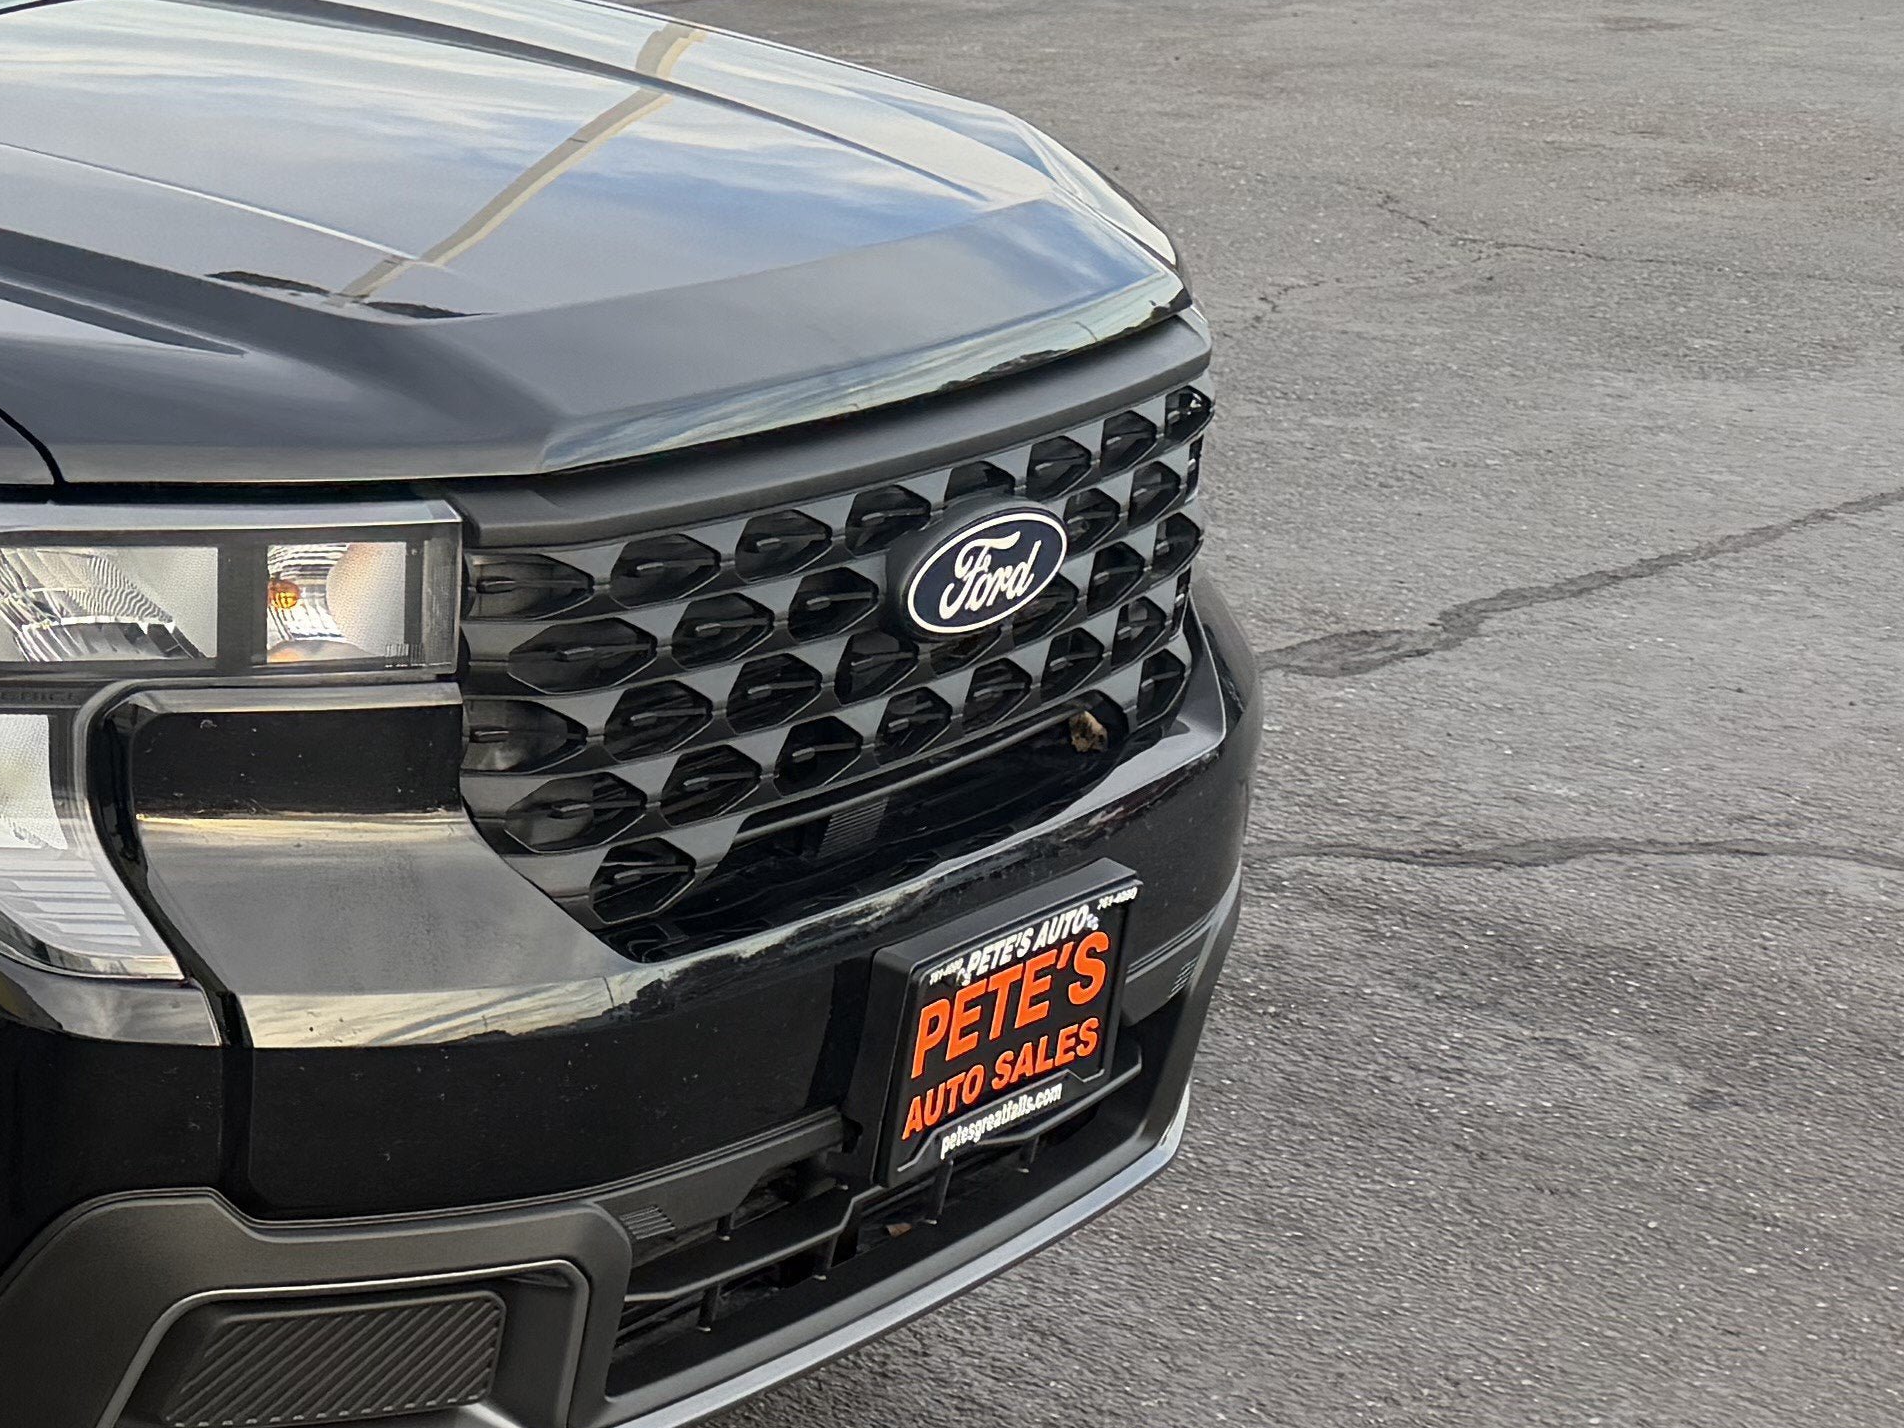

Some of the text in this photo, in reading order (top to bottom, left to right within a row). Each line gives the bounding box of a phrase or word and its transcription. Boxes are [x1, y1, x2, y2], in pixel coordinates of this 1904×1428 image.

[938, 530, 1042, 620] Ford
[967, 926, 1035, 976] PETE'S
[1032, 904, 1090, 952] AUTO
[910, 930, 1111, 1080] PETE'S
[901, 1017, 1101, 1141] AUTO SALES
[940, 1083, 1063, 1161] petesgreatfalls.com
